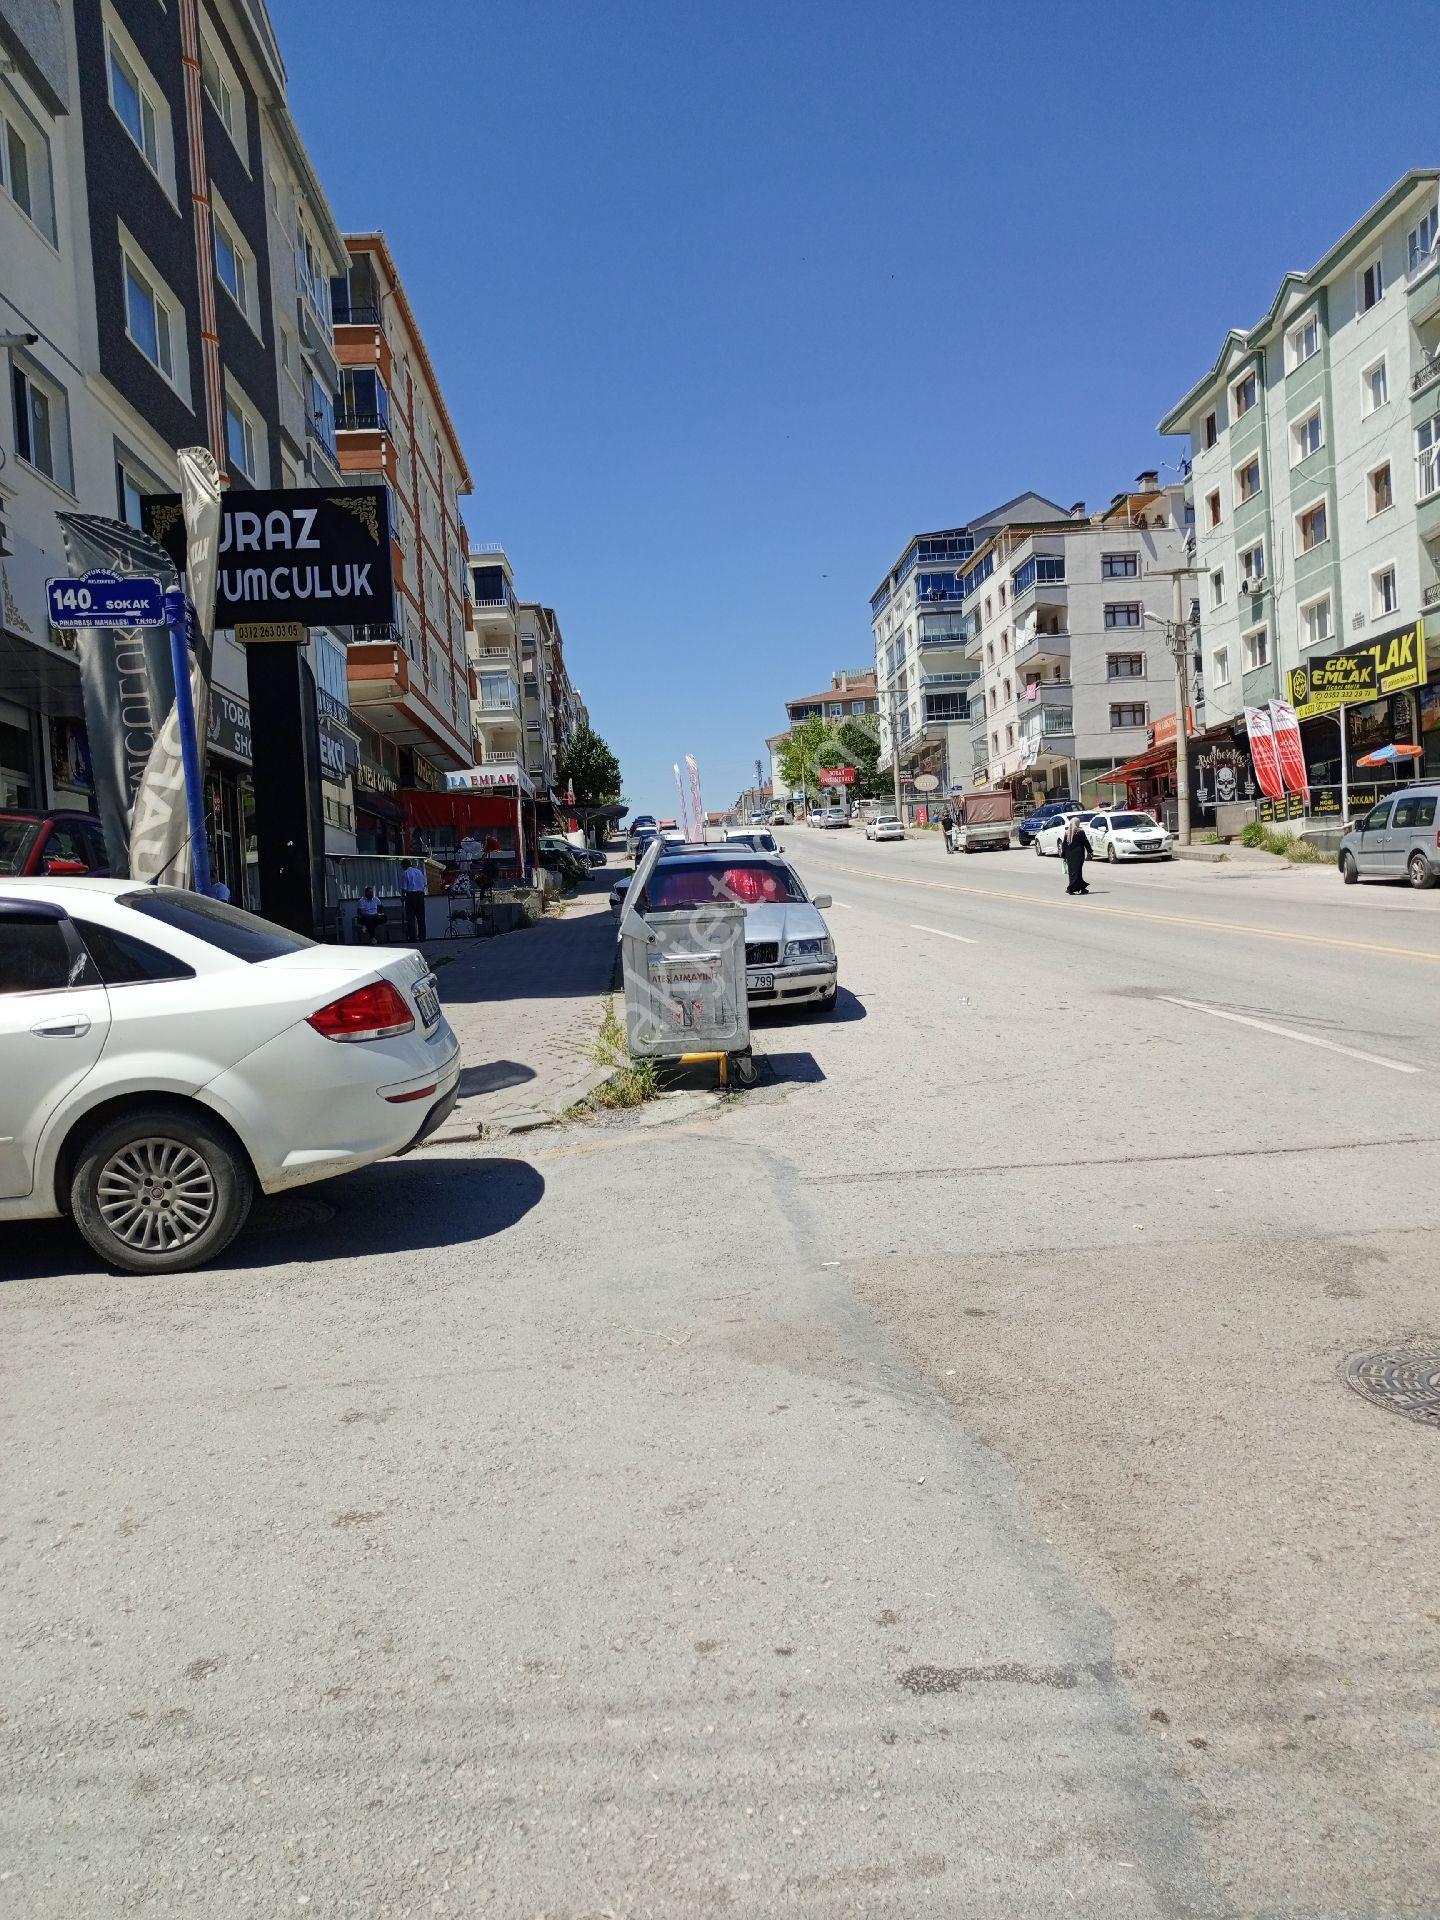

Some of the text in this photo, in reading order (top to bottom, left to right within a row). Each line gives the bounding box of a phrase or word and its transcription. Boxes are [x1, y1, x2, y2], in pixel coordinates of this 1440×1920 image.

[106, 599, 150, 609] SOKAK
[238, 625, 298, 639] 0312 263 03 05
[1325, 656, 1358, 671] GÖK
[1312, 666, 1372, 685] EMLAK
[471, 773, 517, 786] EMLAK
[754, 976, 772, 987] 799
